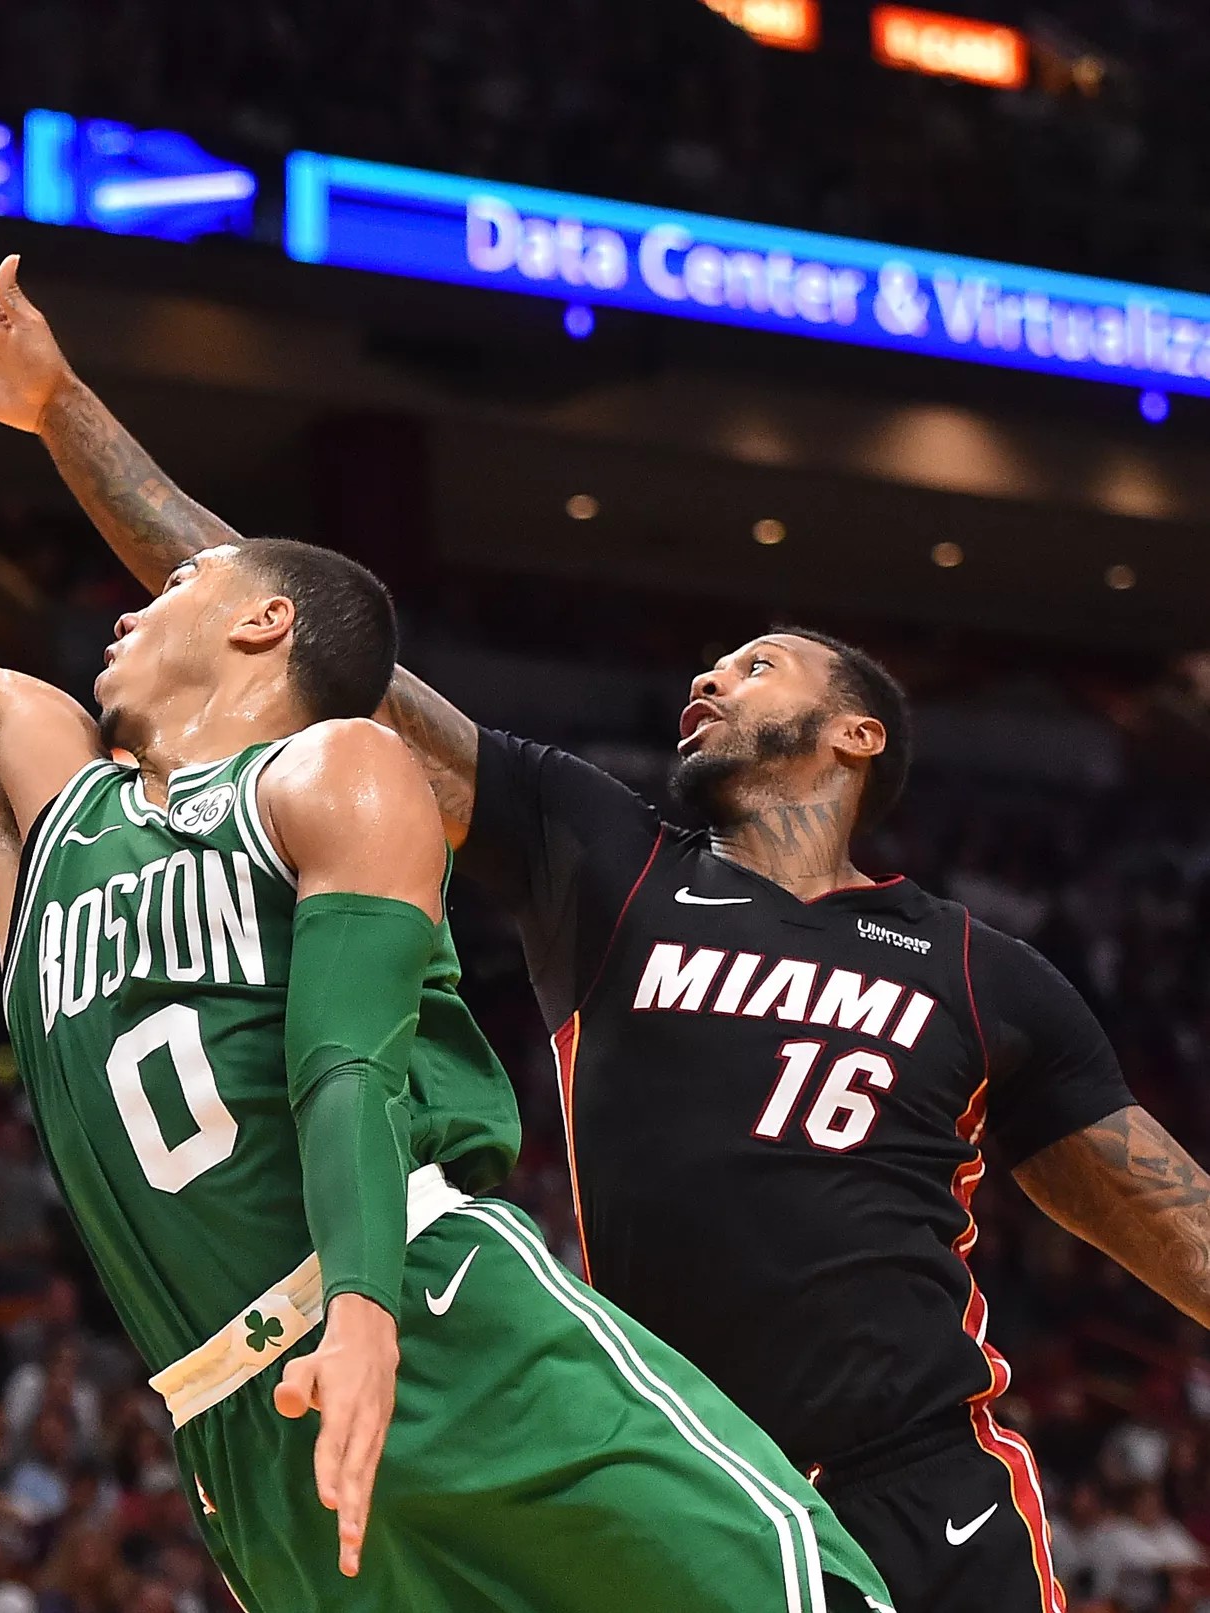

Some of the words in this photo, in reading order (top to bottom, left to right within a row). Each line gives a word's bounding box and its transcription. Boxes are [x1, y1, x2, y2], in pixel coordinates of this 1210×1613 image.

[466, 194, 628, 291] Data
[639, 222, 866, 327] Center
[872, 260, 930, 338] &
[39, 849, 265, 1041] BOSTON
[632, 941, 938, 1051] MIAMI
[106, 1003, 238, 1194] 0
[750, 1037, 898, 1153] 16
